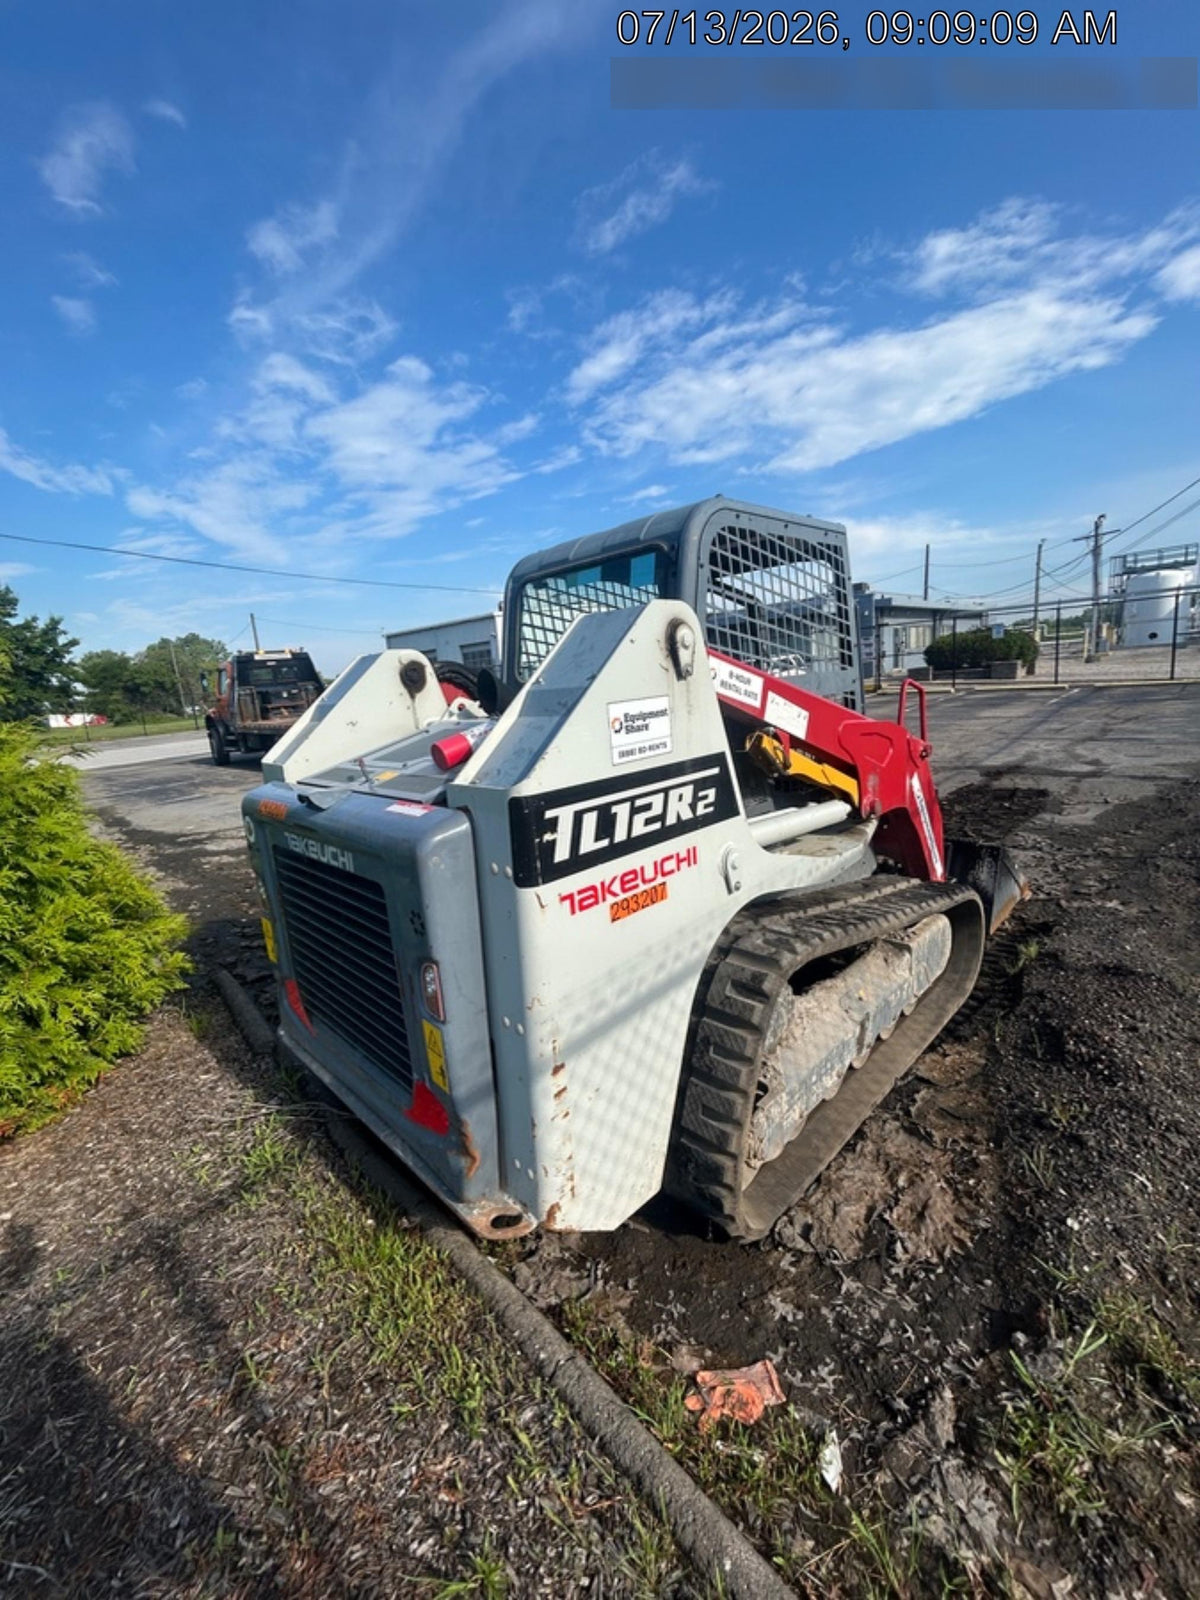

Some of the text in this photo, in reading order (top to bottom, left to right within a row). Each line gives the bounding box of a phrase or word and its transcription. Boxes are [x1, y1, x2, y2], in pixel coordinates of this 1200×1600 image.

[623, 708, 669, 724] Equipment
[625, 722, 650, 735] Share
[283, 831, 355, 873] TAKEUCHI
[558, 846, 698, 917] TAKEUCHI
[610, 881, 667, 923] 293207
